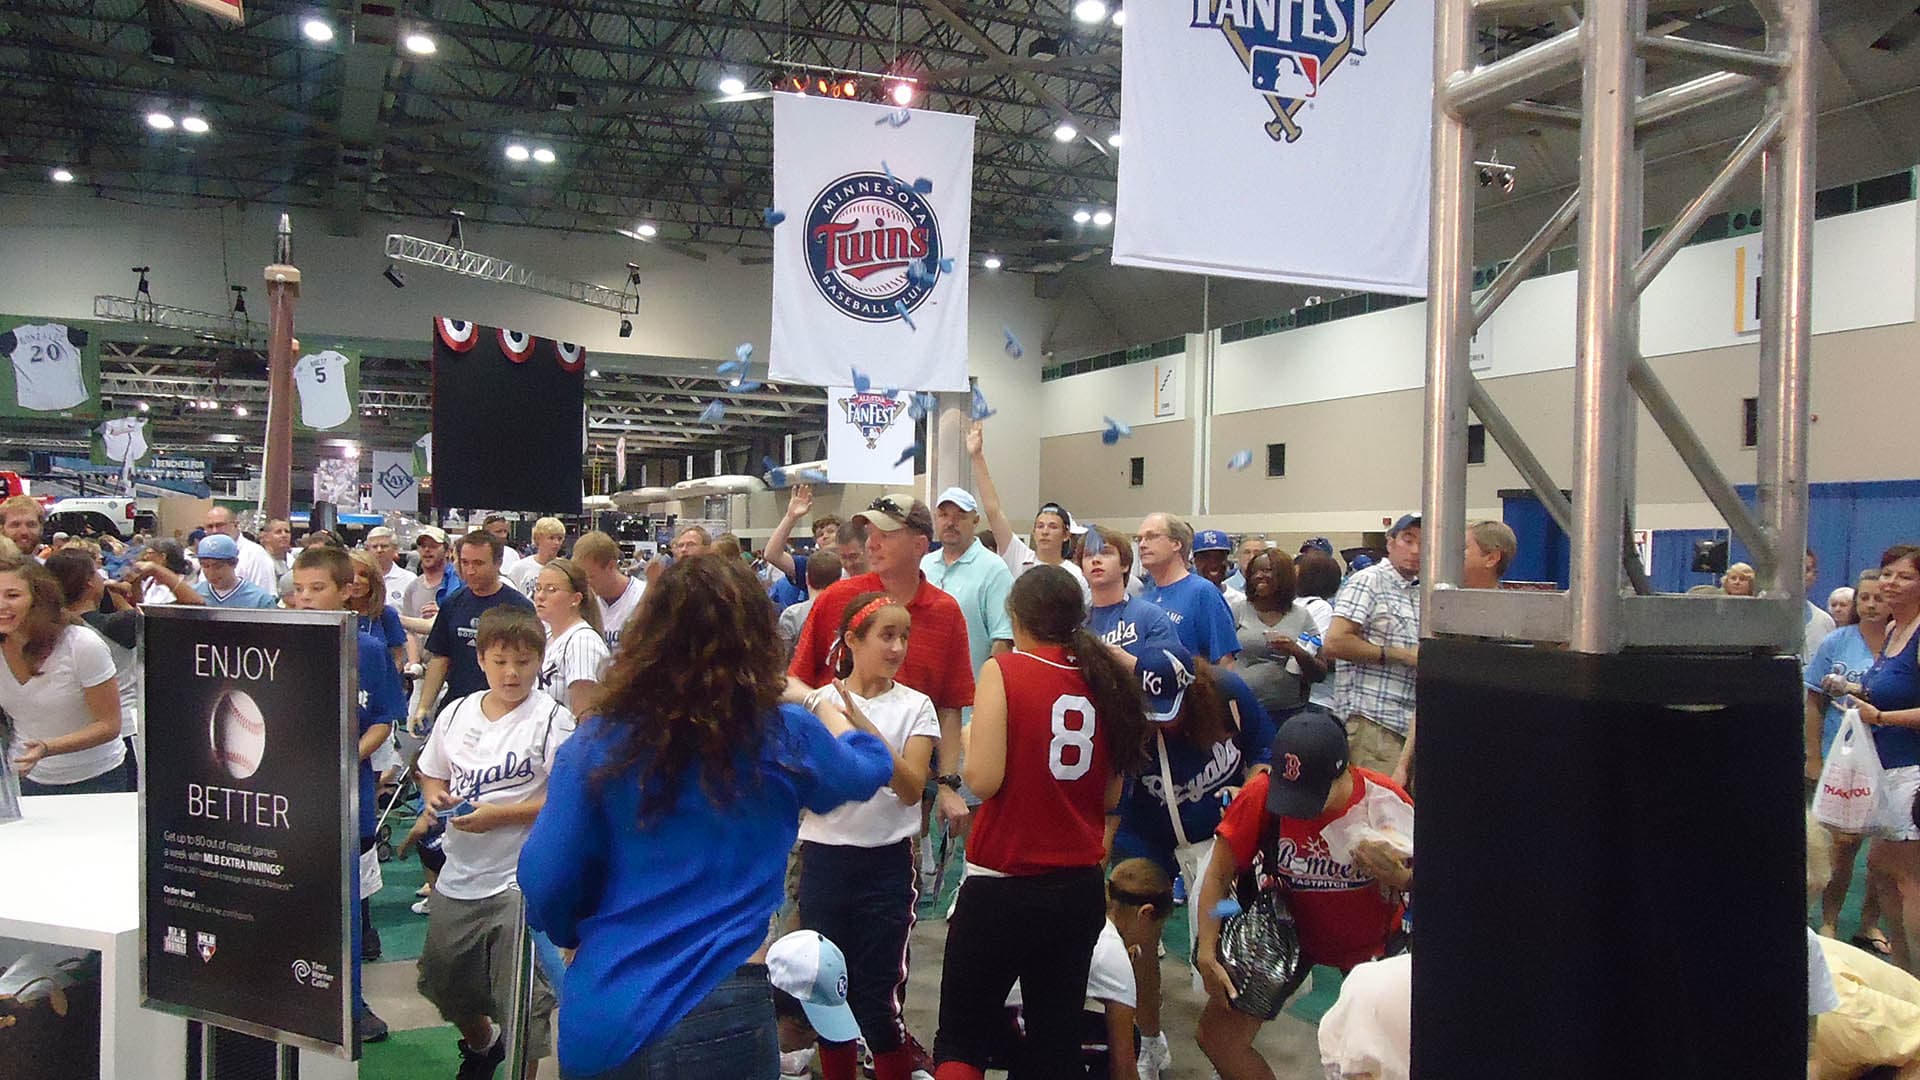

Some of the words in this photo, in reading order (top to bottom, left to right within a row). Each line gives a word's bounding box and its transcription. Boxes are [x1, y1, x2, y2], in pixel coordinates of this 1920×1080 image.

[822, 181, 926, 225] MINNESOTA
[814, 217, 929, 273] Twins
[822, 275, 889, 314] BASEBALL
[30, 343, 61, 363] 20
[315, 366, 327, 384] 5
[846, 401, 897, 426] FANFEST
[195, 644, 281, 682] ENJOY
[1142, 670, 1162, 696] KC
[1048, 694, 1096, 780] 8
[449, 751, 535, 802] Royals
[1283, 753, 1301, 781] B
[188, 783, 290, 830] BETTER
[163, 830, 176, 841] Get
[177, 834, 187, 844] up
[187, 834, 195, 845] to
[195, 835, 206, 847] 80
[206, 838, 218, 849] out
[219, 839, 227, 850] of
[226, 842, 252, 854] market
[252, 847, 278, 858] games
[203, 852, 220, 865] MLB
[220, 856, 246, 869] EXTRA
[163, 885, 181, 895] Order
[311, 961, 328, 972] Time
[311, 978, 329, 989] Cable
